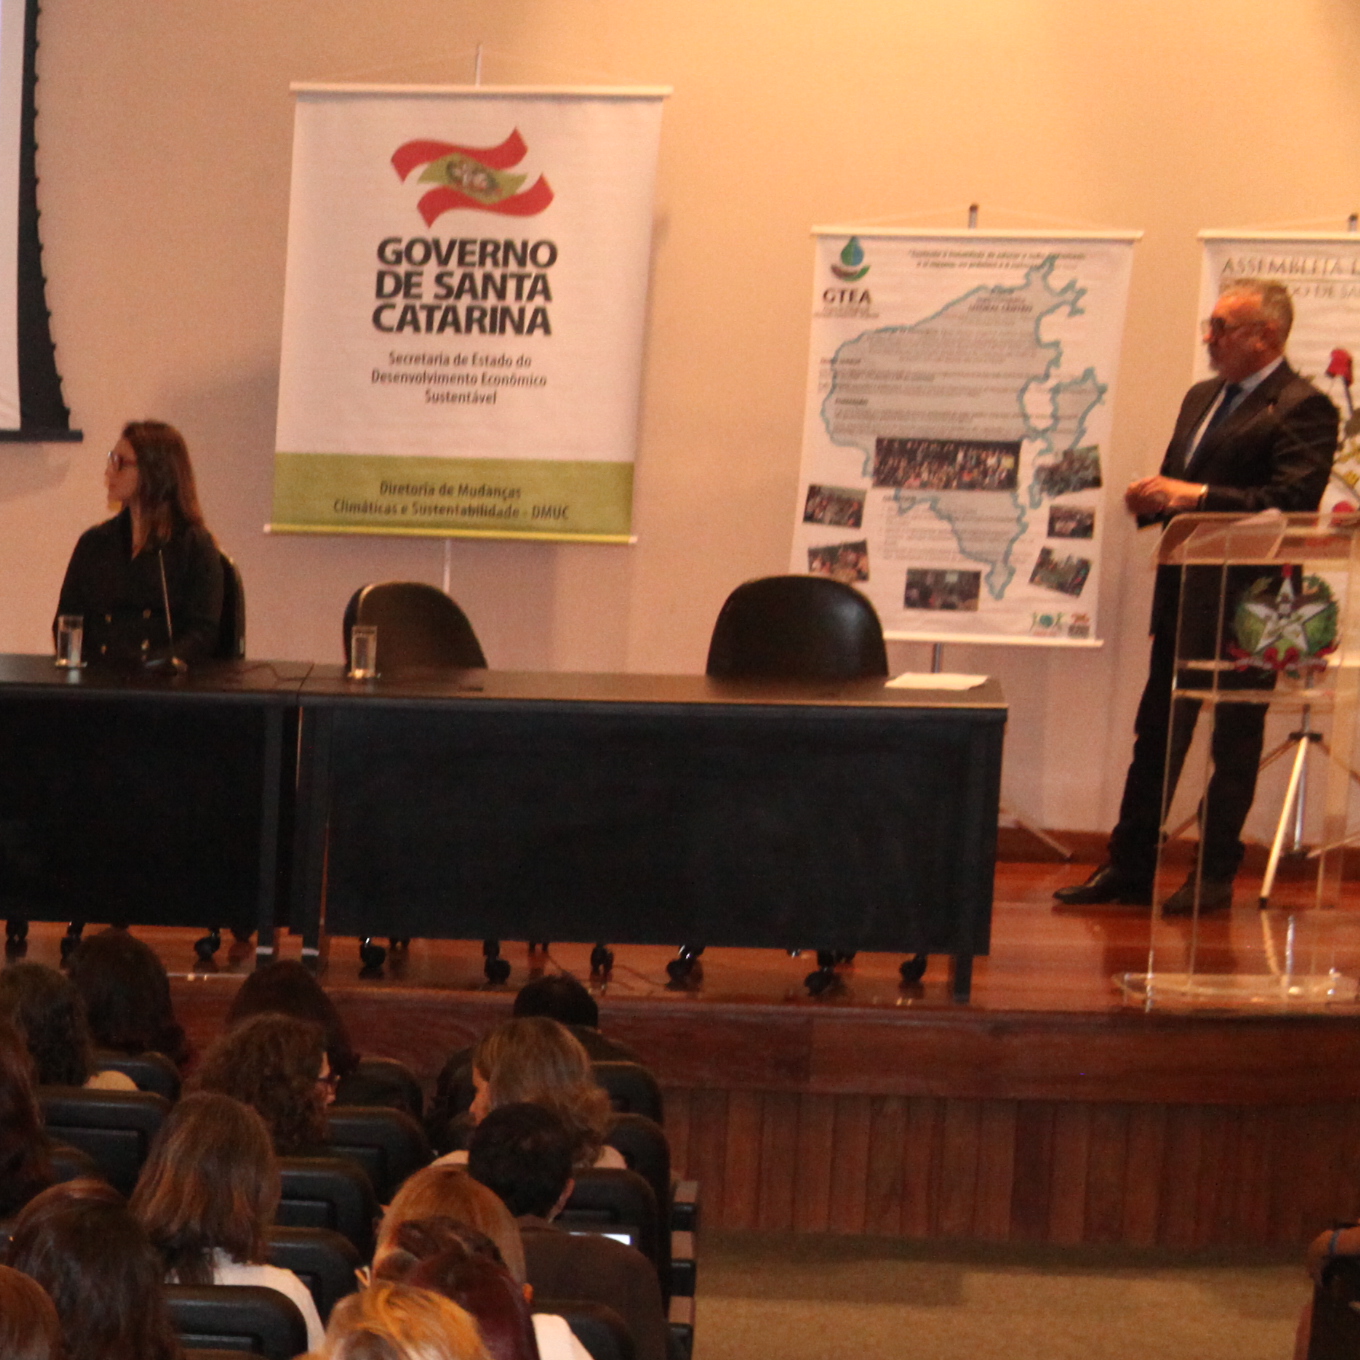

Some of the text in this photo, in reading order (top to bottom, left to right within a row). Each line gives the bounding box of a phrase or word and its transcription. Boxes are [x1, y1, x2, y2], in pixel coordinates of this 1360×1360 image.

[377, 237, 558, 269] GOVERNO
[375, 269, 553, 303] DE SANTA
[371, 303, 553, 336] CATARINA
[389, 351, 531, 368] Secretaria de Estado do
[371, 368, 547, 387] Desenvolvimento Econômico
[425, 389, 497, 405] Sustentável
[380, 481, 521, 500] Diretoria de Mudanças
[333, 499, 397, 515] Climáticas
[412, 502, 519, 519] Sustentabilidade
[531, 505, 570, 520] DMUC
